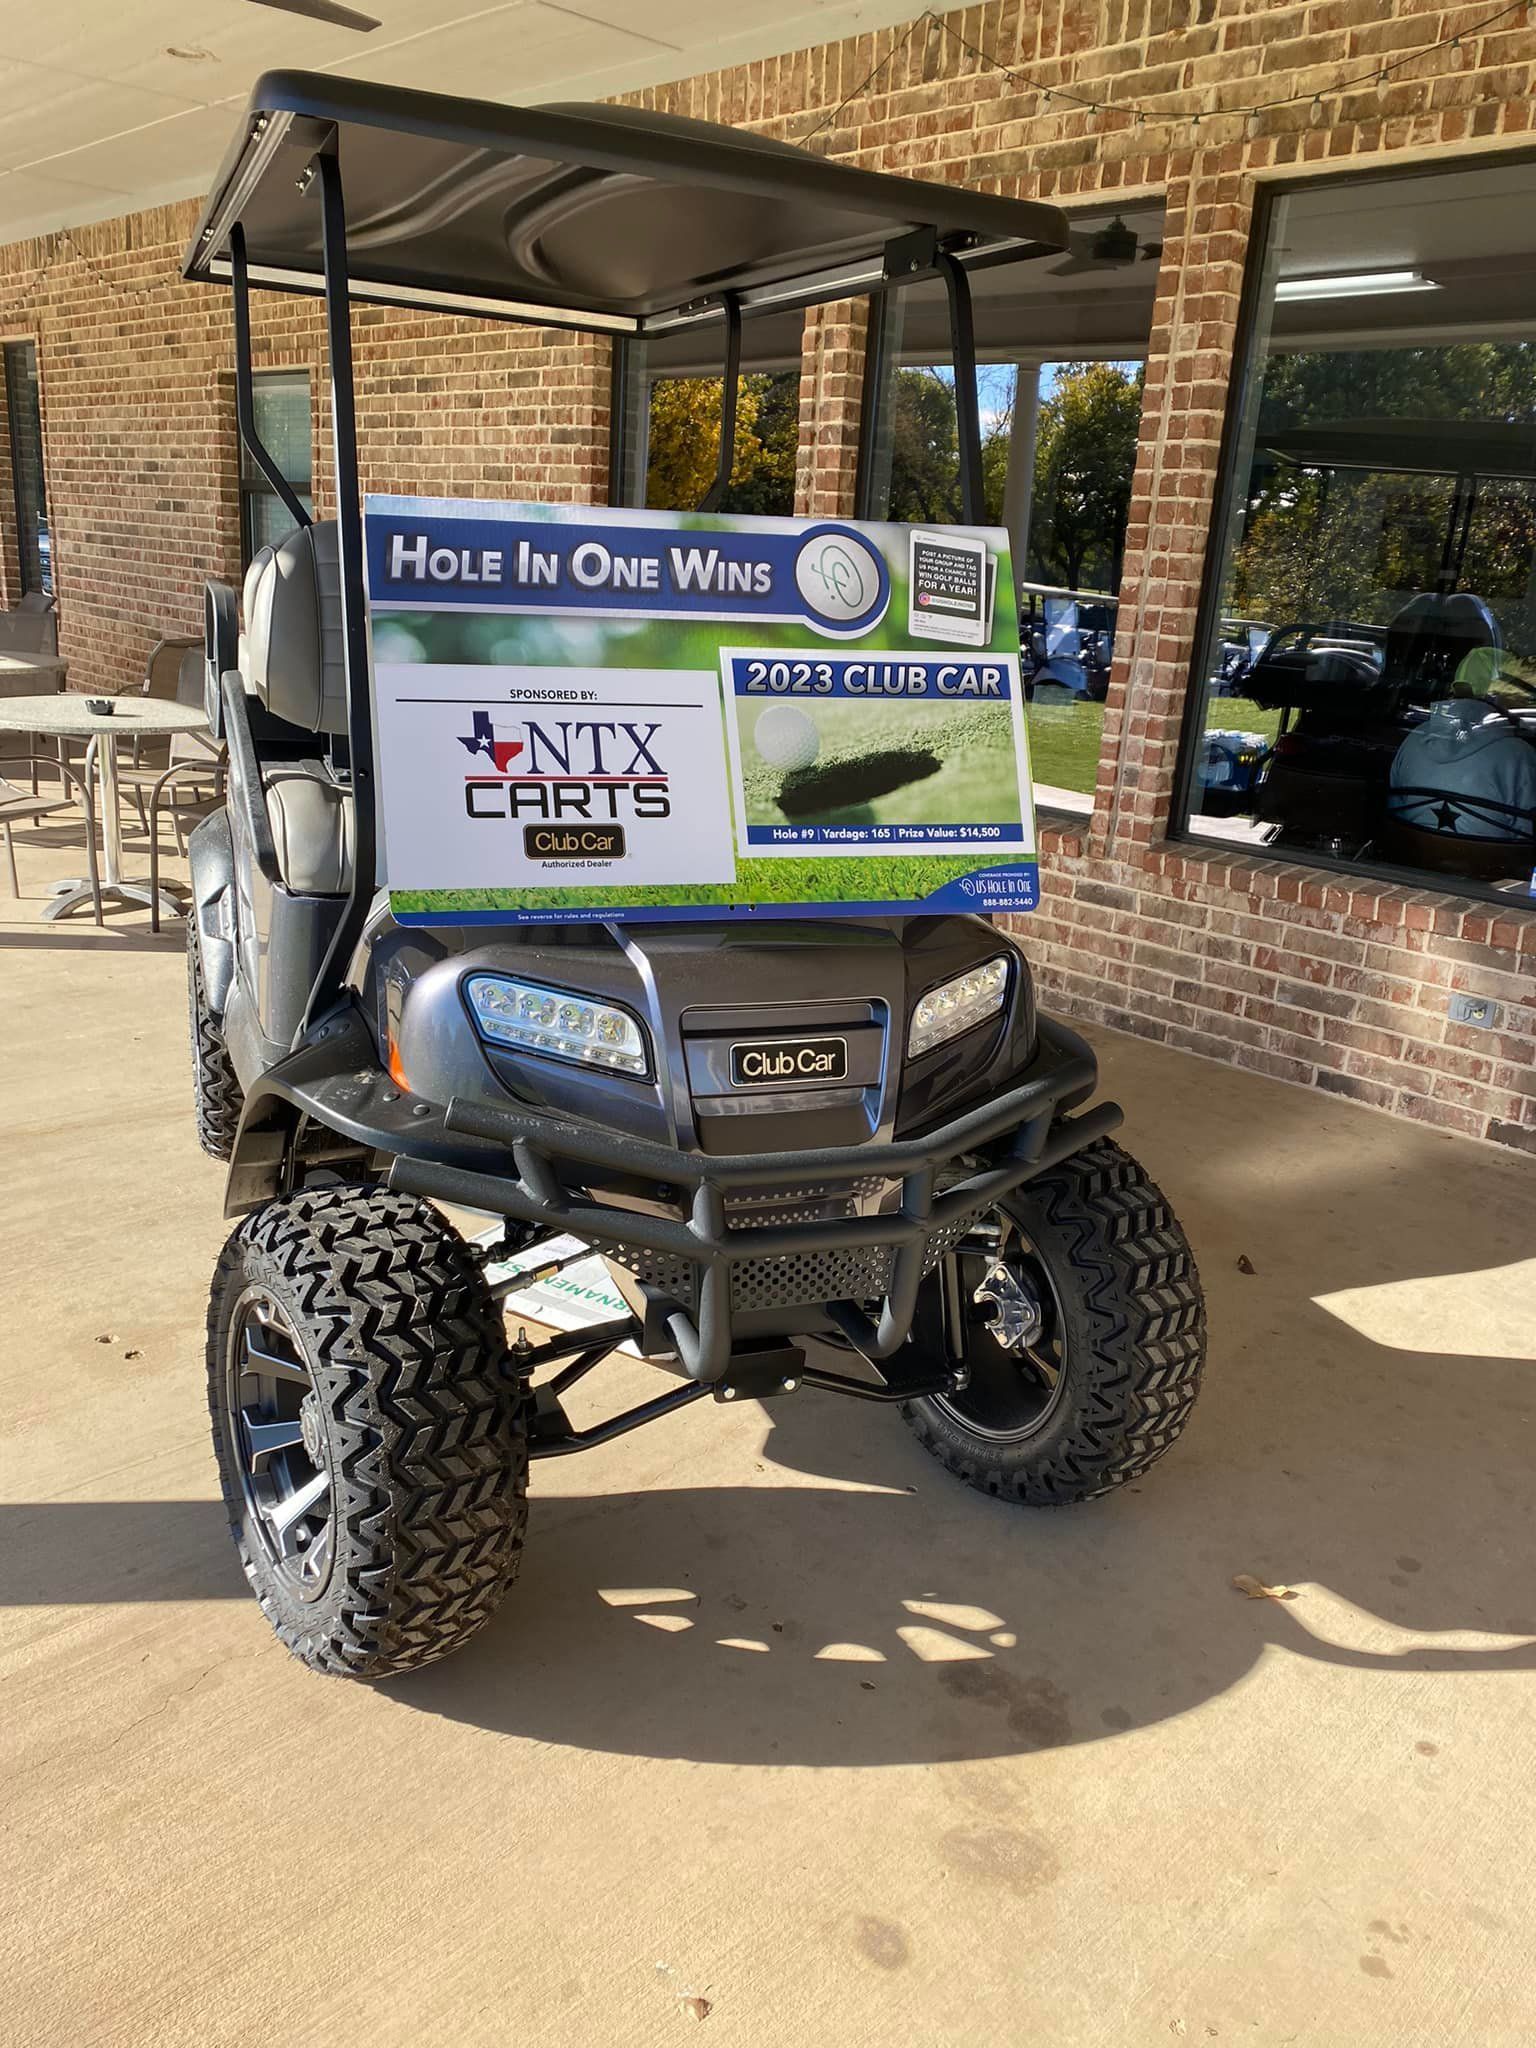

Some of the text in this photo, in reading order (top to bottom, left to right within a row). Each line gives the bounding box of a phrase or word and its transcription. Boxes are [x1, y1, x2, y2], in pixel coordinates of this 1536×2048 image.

[922, 550, 936, 558] POST
[943, 554, 965, 563] PICTURE
[935, 559, 954, 567] GROUP
[391, 535, 772, 594] HOLE IN ONE WINS
[919, 571, 977, 586] WIN GOLF BALLS
[945, 568, 967, 577] CHANCE
[919, 580, 977, 597] FOR A YEAR!
[747, 662, 1001, 697] 2023 CLUB CAR
[510, 688, 598, 700] SPONSORED BY:
[522, 721, 669, 776] NTX
[465, 782, 671, 819] CARTS
[773, 826, 1001, 841] Hole #9 Yardage: 165 Prize Value: $14,500
[535, 832, 615, 851] Club Car
[542, 860, 612, 868] Authorized Dealer
[976, 879, 986, 893] US
[987, 879, 1007, 893] HOLE
[592, 911, 624, 919] regulations
[743, 1049, 836, 1076] Club Car
